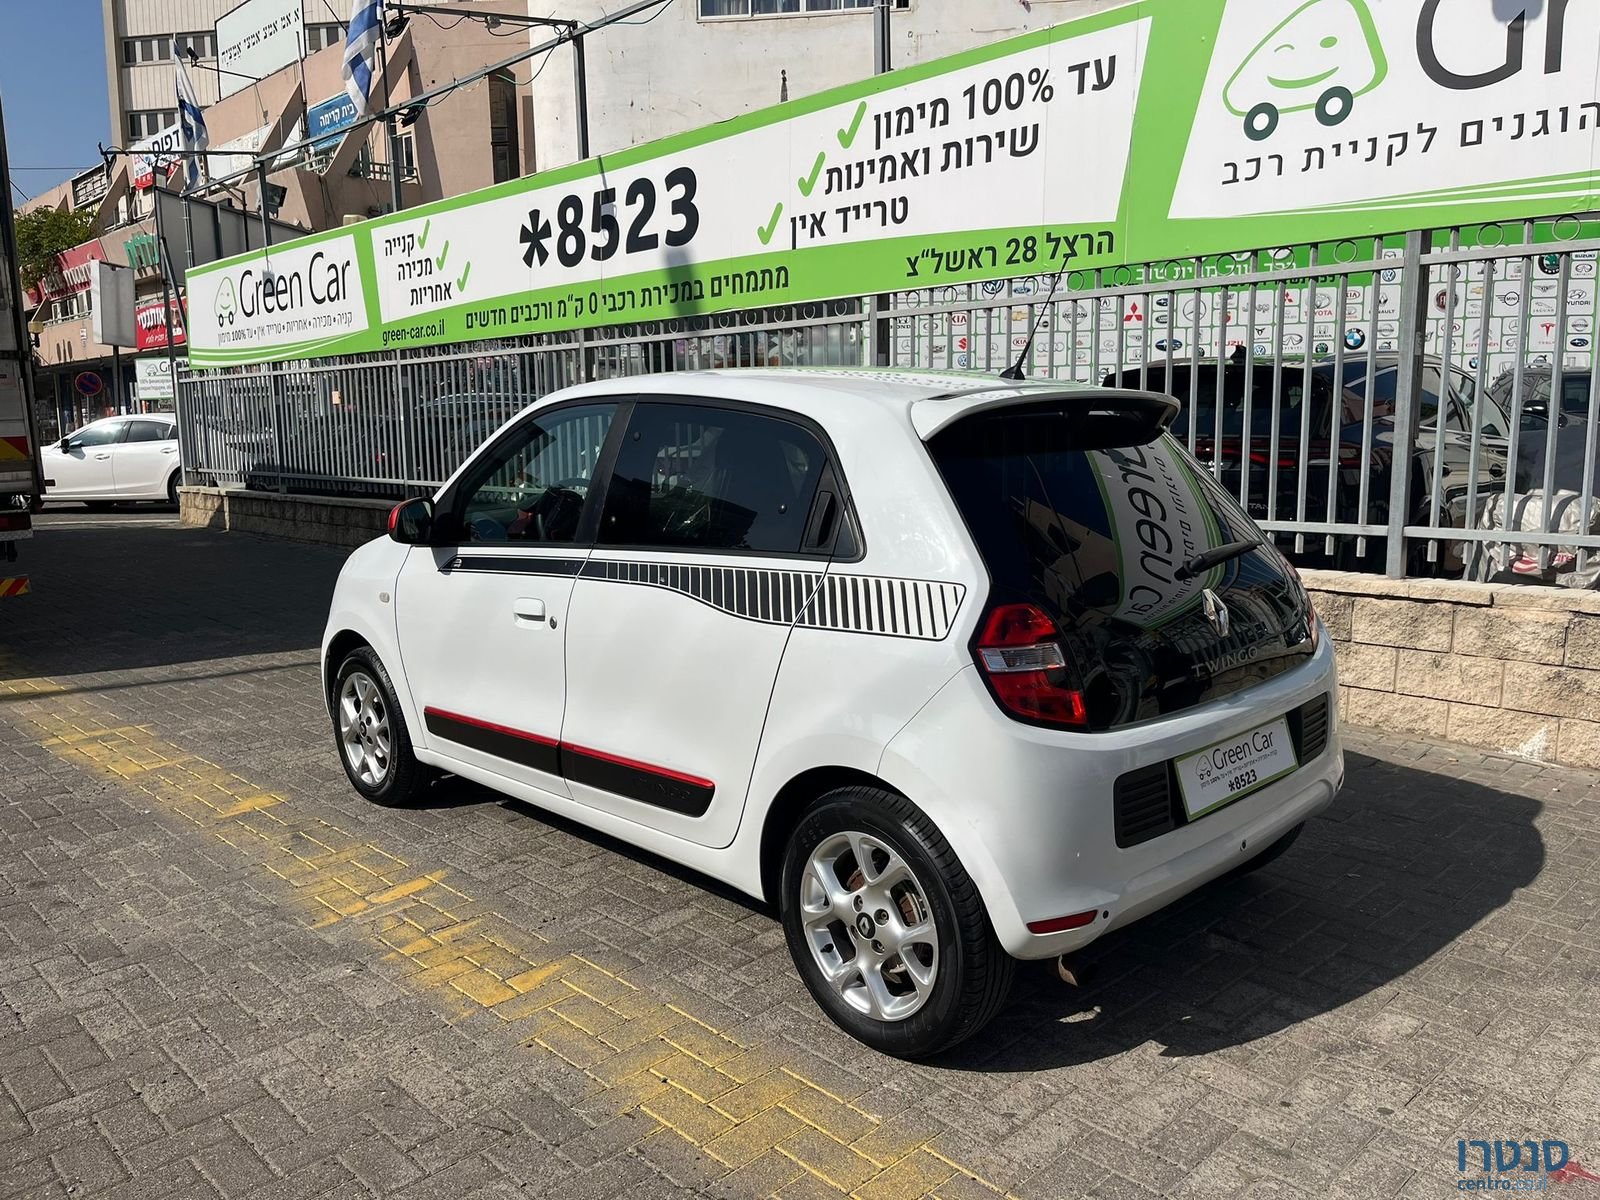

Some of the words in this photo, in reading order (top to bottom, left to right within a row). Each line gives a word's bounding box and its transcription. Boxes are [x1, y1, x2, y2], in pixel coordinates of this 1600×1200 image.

[1068, 55, 1117, 95] עד
[963, 67, 1054, 120] 100%
[342, 103, 355, 117] בית
[874, 99, 949, 150] מימון
[152, 129, 180, 158] דפוס
[941, 124, 1039, 172] שירות
[1301, 123, 1437, 172] לקניית
[825, 148, 930, 195] ואמינות
[1222, 154, 1283, 185] רכב
[836, 196, 909, 233] טרייד
[790, 209, 825, 250] אין
[384, 231, 414, 257] קנייה
[1006, 237, 1036, 265] 28
[1047, 230, 1113, 260] הרצל
[397, 257, 432, 282] מכירה
[710, 266, 789, 298] מתמחים
[239, 269, 303, 318] Green
[309, 251, 350, 305] Car
[410, 281, 452, 306] אחריות
[640, 280, 704, 308] במכירת
[511, 300, 552, 325] ורכבים
[589, 292, 598, 315] 0
[602, 289, 637, 313] רכבי
[1304, 309, 1333, 317] TYOTA
[312, 317, 332, 329] מכירה
[337, 312, 353, 327] קניה
[382, 319, 445, 346] green-car.co.il
[466, 307, 506, 330] חדשים
[231, 329, 246, 341] 100%
[1214, 340, 1244, 348] IUZU
[1191, 646, 1258, 677] TWINGO
[1212, 741, 1252, 770] Green
[1252, 729, 1273, 753] Car
